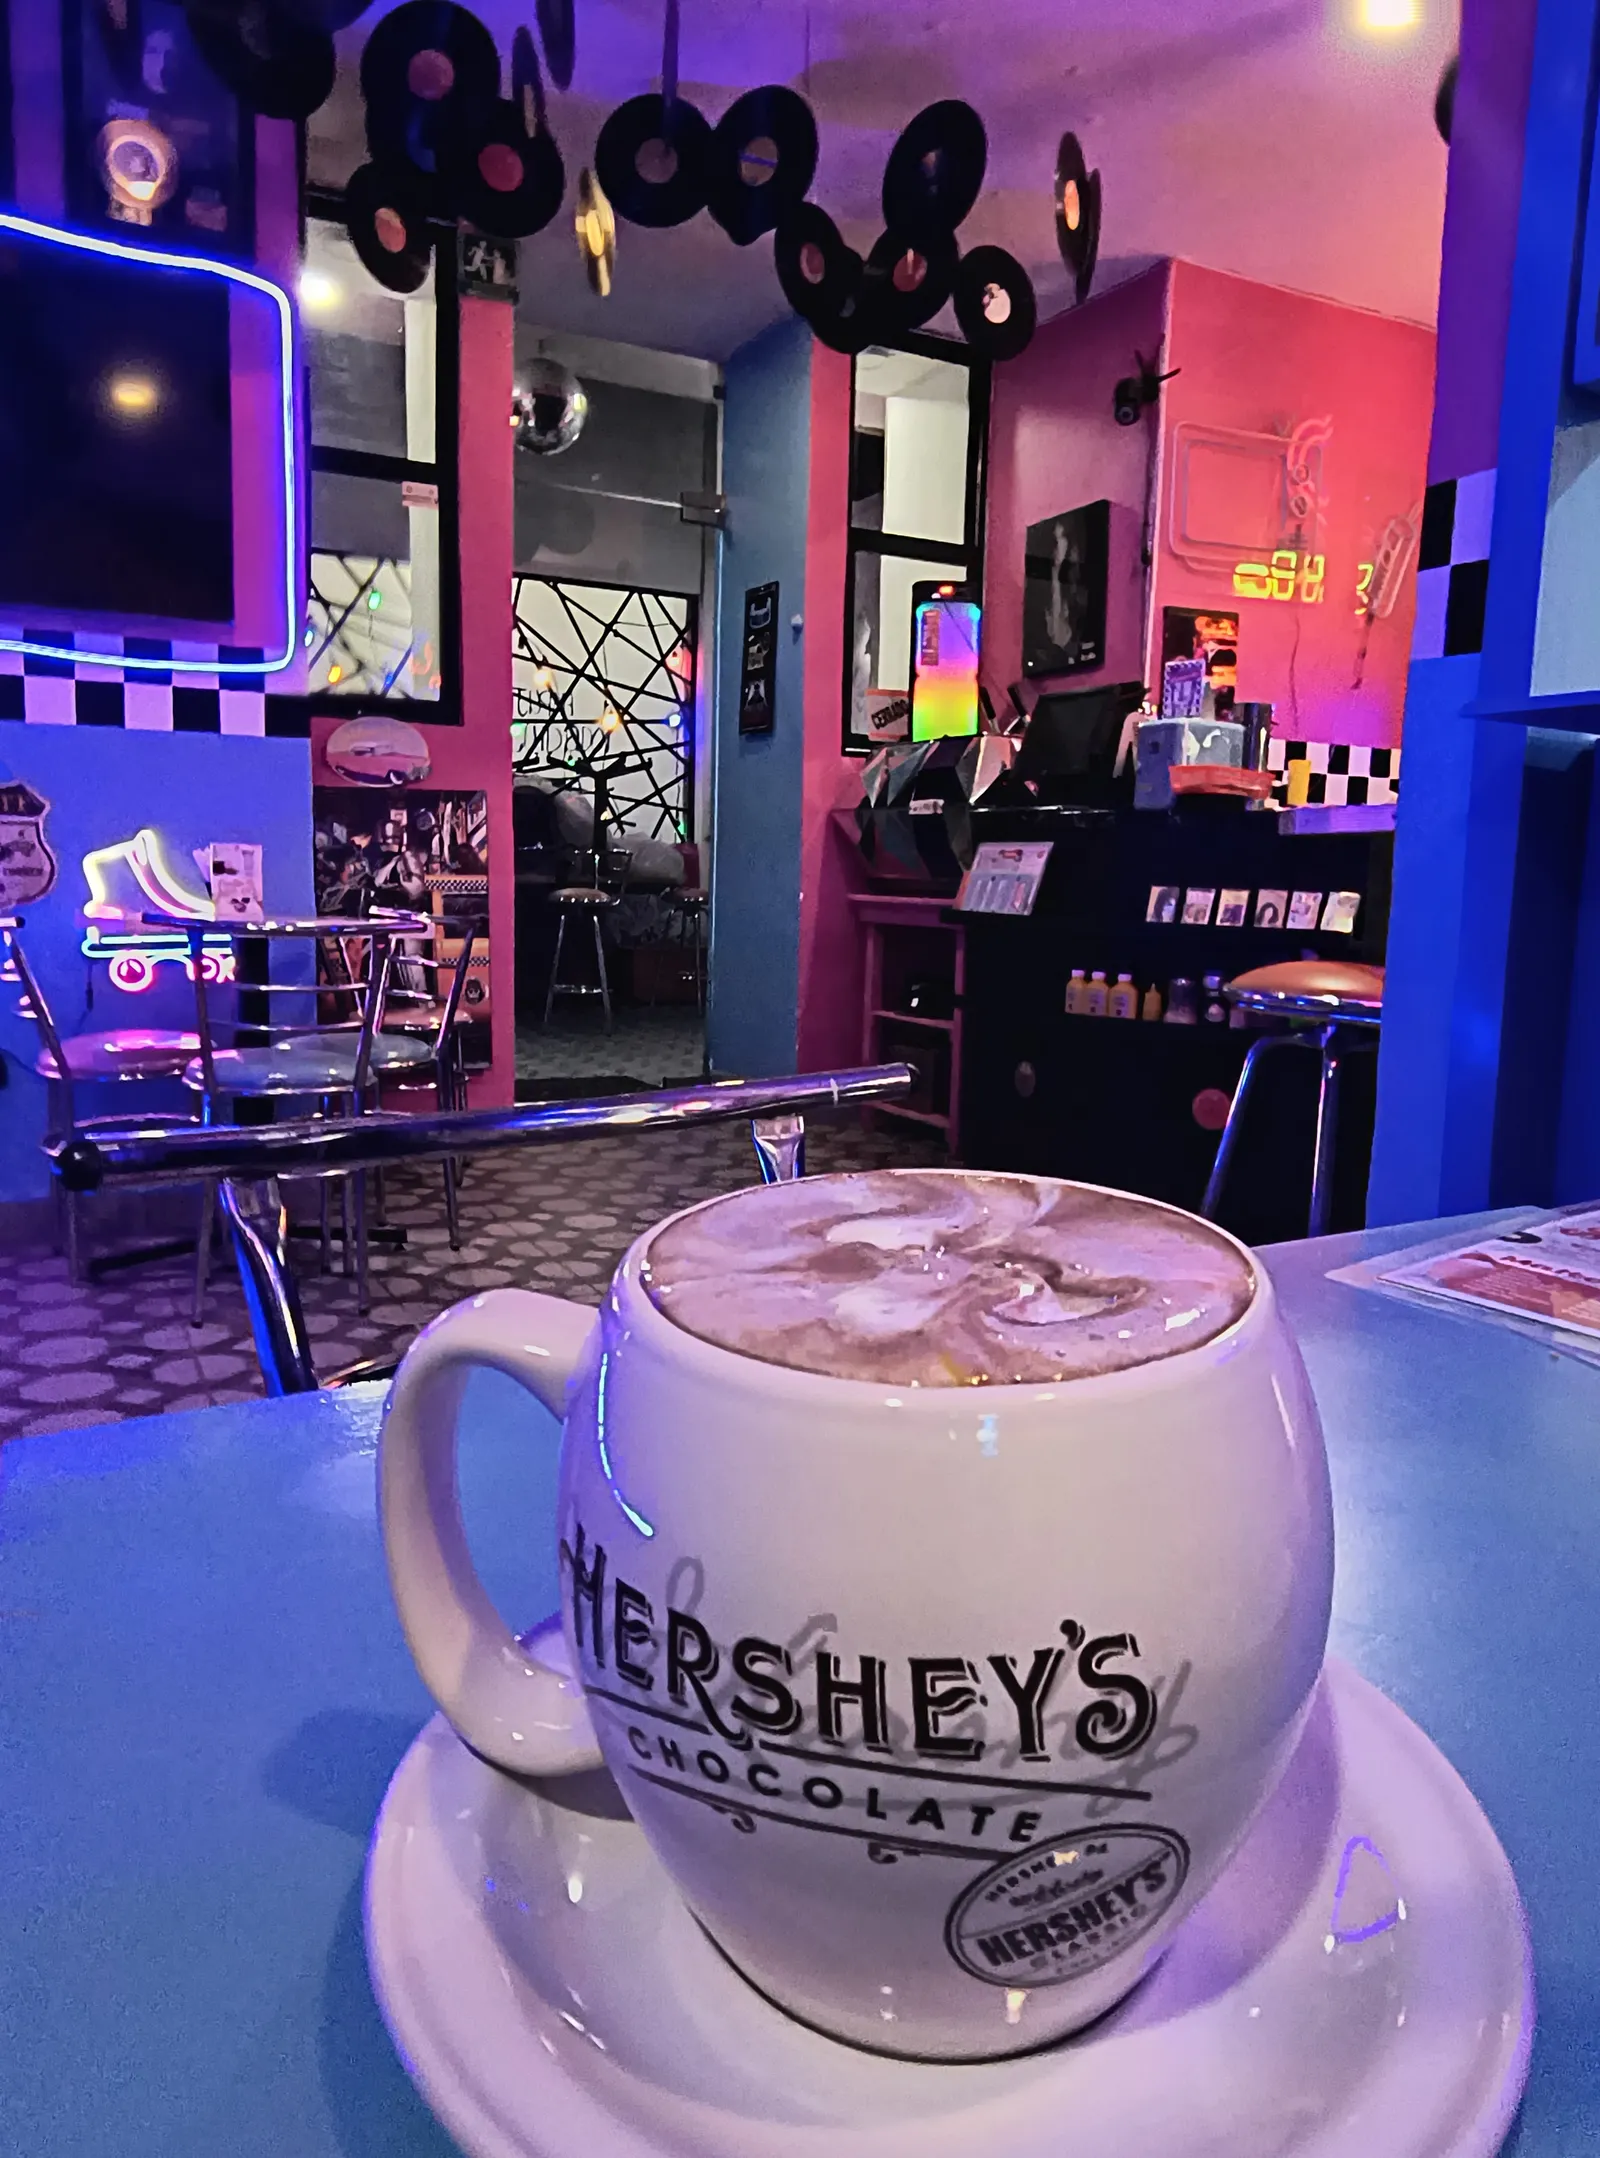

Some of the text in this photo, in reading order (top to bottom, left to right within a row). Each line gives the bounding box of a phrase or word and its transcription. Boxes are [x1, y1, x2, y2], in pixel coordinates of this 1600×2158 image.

[560, 1524, 1158, 1763] HERSHEY'S
[627, 1725, 1044, 1844] CHOCOLATE
[976, 1850, 1173, 1967] HERSHEY'S
